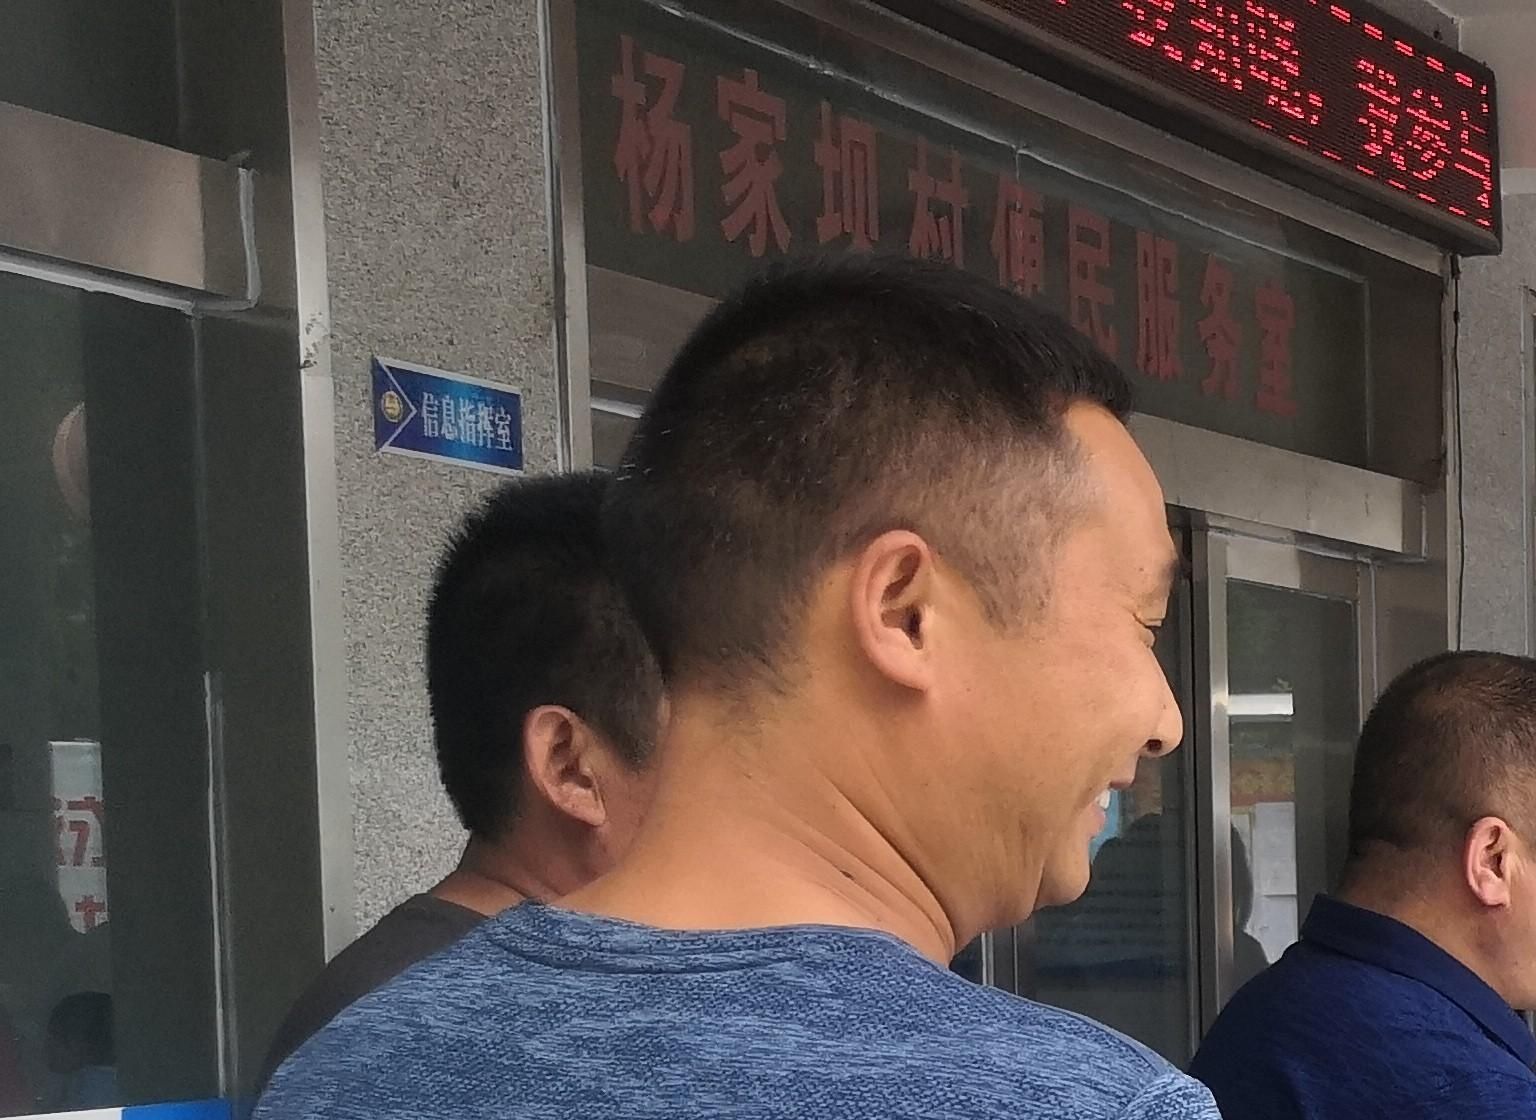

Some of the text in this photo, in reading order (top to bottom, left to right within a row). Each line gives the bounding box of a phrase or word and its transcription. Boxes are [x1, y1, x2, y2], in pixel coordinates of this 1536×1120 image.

[421, 391, 513, 451] 信息指挥室
